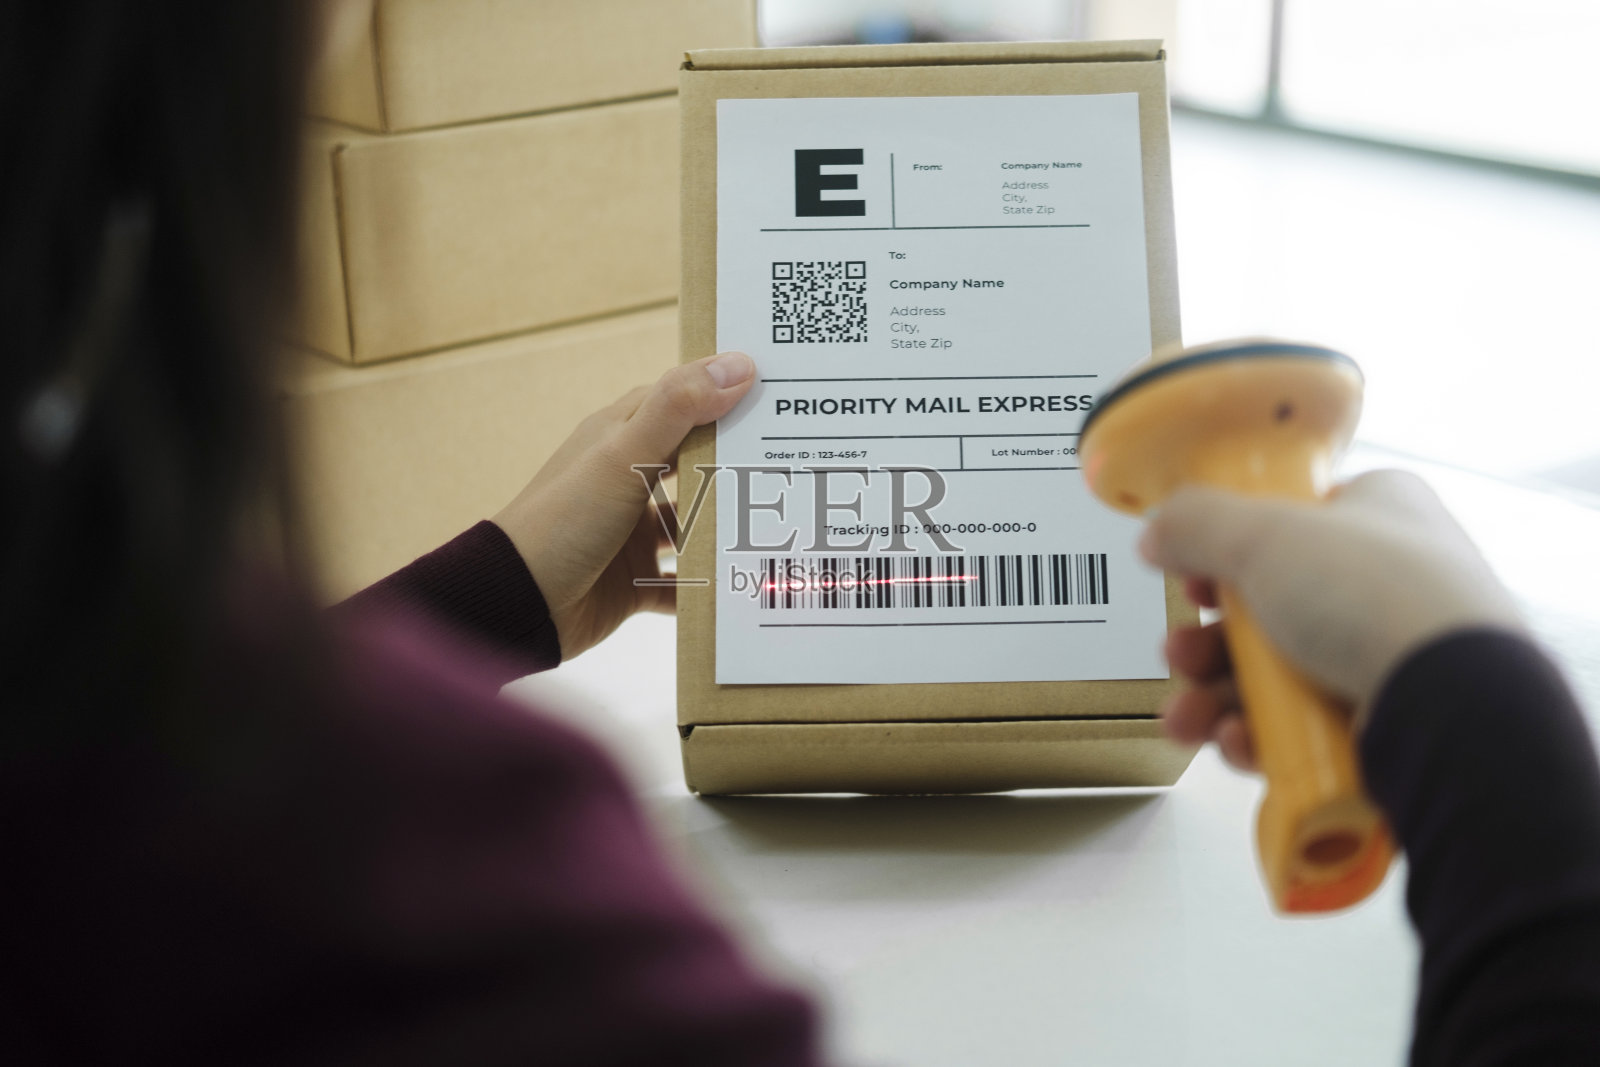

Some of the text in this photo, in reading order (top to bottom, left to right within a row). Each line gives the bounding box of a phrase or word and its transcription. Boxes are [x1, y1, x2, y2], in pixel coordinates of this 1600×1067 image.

[912, 163, 943, 172] From:
[1000, 161, 1083, 171] Company Name
[794, 148, 866, 217] E
[1001, 181, 1049, 190] Address
[1001, 193, 1028, 203] City,
[1002, 205, 1056, 215] State Zip
[888, 251, 907, 260] To:
[889, 278, 1005, 292] Company Name
[889, 305, 947, 317] Address
[889, 322, 920, 335] City,
[890, 337, 953, 350] State Zip
[775, 395, 1093, 416] PRIORITY MAIL EXPRESS
[764, 451, 796, 460] Order
[798, 451, 810, 460] ID
[818, 450, 868, 459] 123-456-7
[991, 448, 1009, 457] Lot
[1011, 447, 1055, 457] Number
[824, 524, 890, 537] Tracking
[894, 524, 911, 535] ID
[922, 522, 1038, 535] 000-000-000-0
